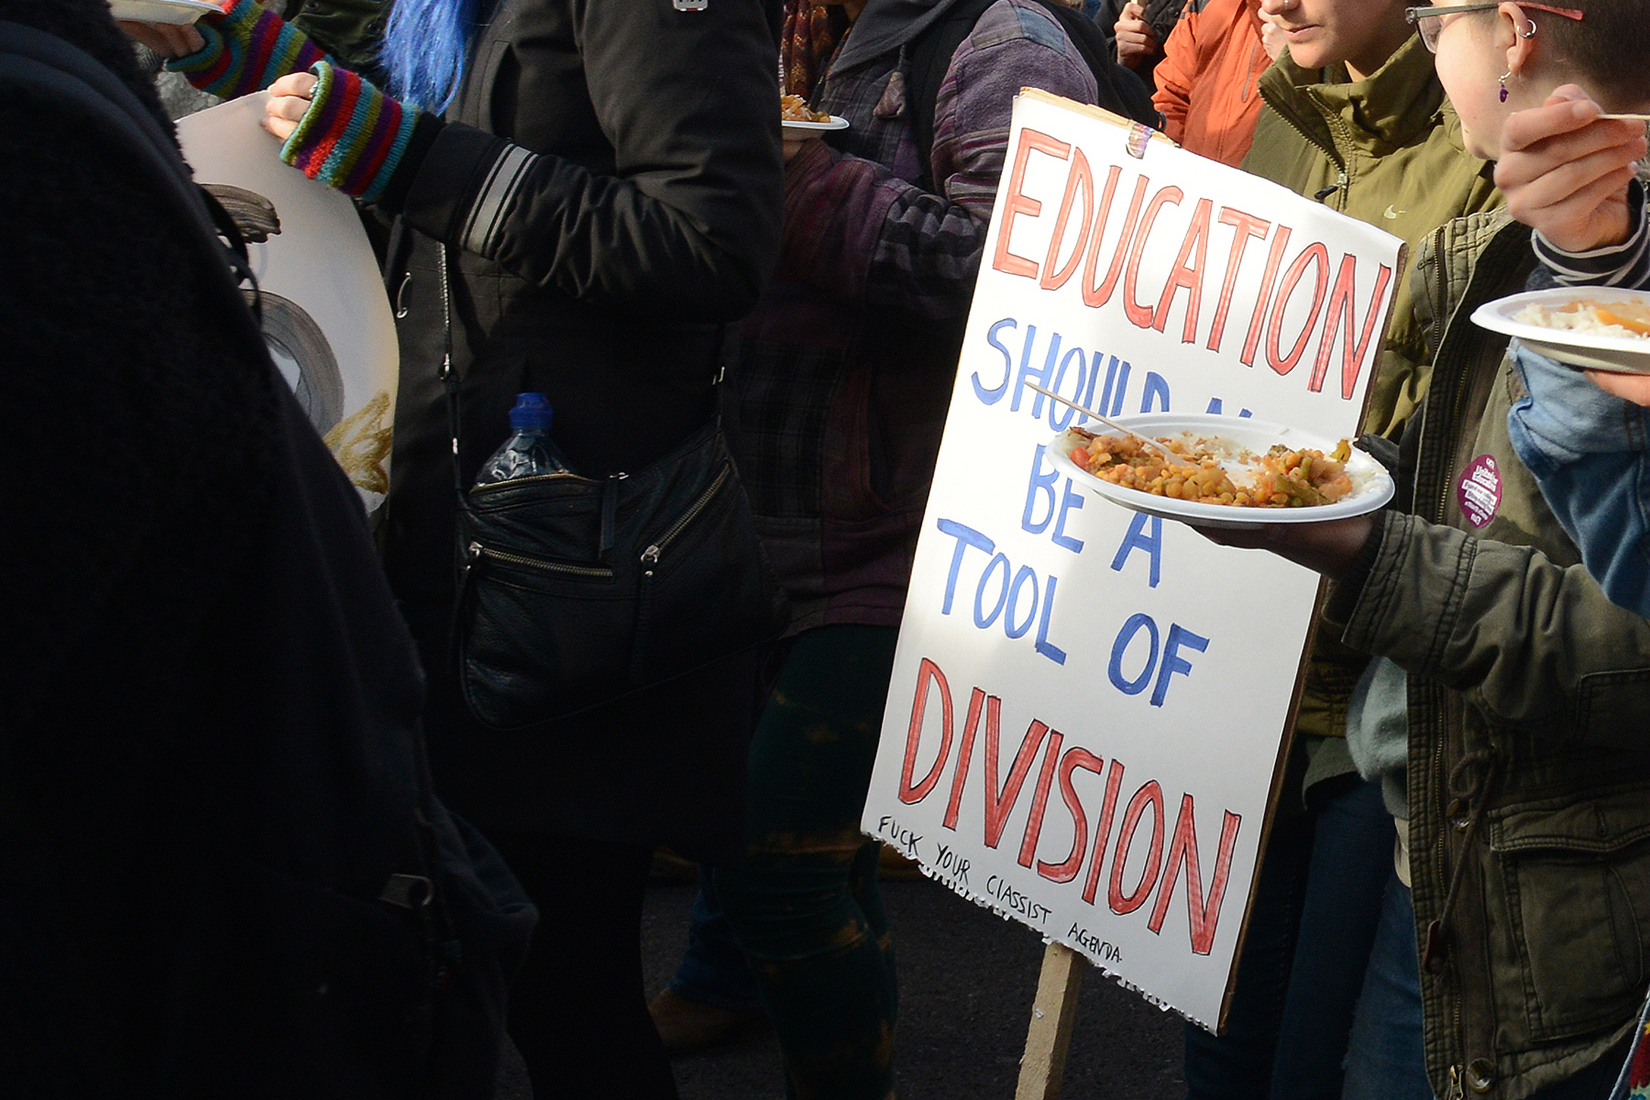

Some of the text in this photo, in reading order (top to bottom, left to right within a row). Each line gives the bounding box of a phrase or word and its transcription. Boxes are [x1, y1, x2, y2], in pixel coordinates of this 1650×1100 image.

[990, 126, 1393, 402] EDUCATION
[1021, 442, 1163, 590] BE A
[935, 517, 1211, 709] TOOL OF
[878, 815, 924, 857] FUCK
[934, 842, 972, 886] YOUR
[897, 657, 1242, 957] DIVISION
